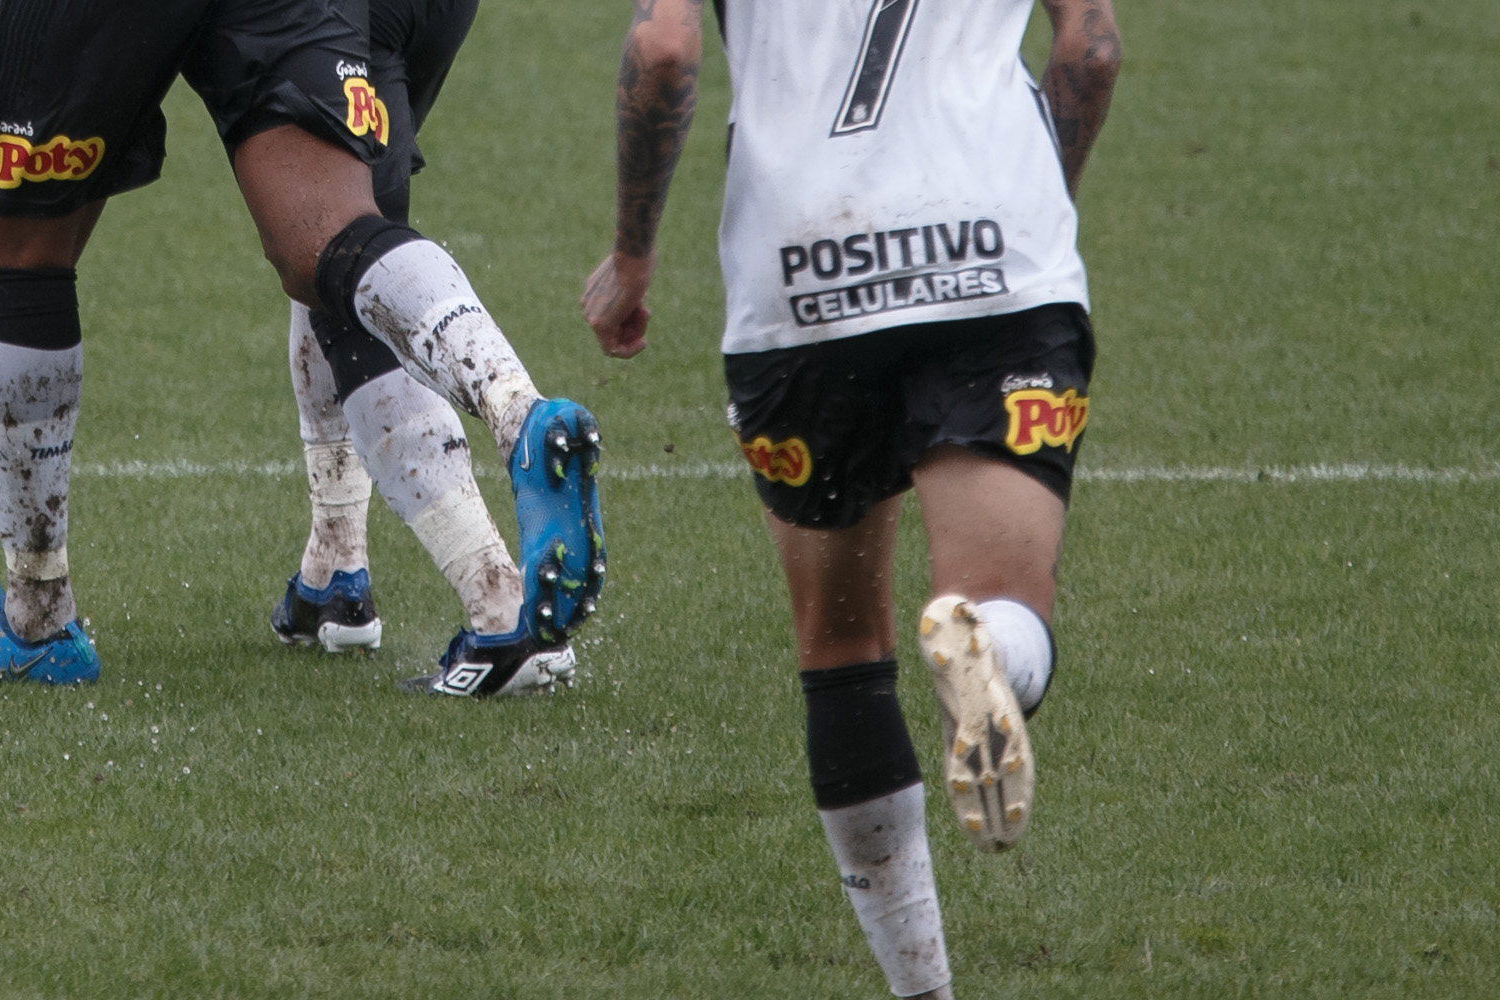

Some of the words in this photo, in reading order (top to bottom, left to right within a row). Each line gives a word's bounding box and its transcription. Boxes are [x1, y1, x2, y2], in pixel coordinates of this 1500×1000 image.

[779, 219, 1006, 287] POSITIVO
[795, 269, 1005, 325] CELULARES
[743, 444, 806, 481] oty
